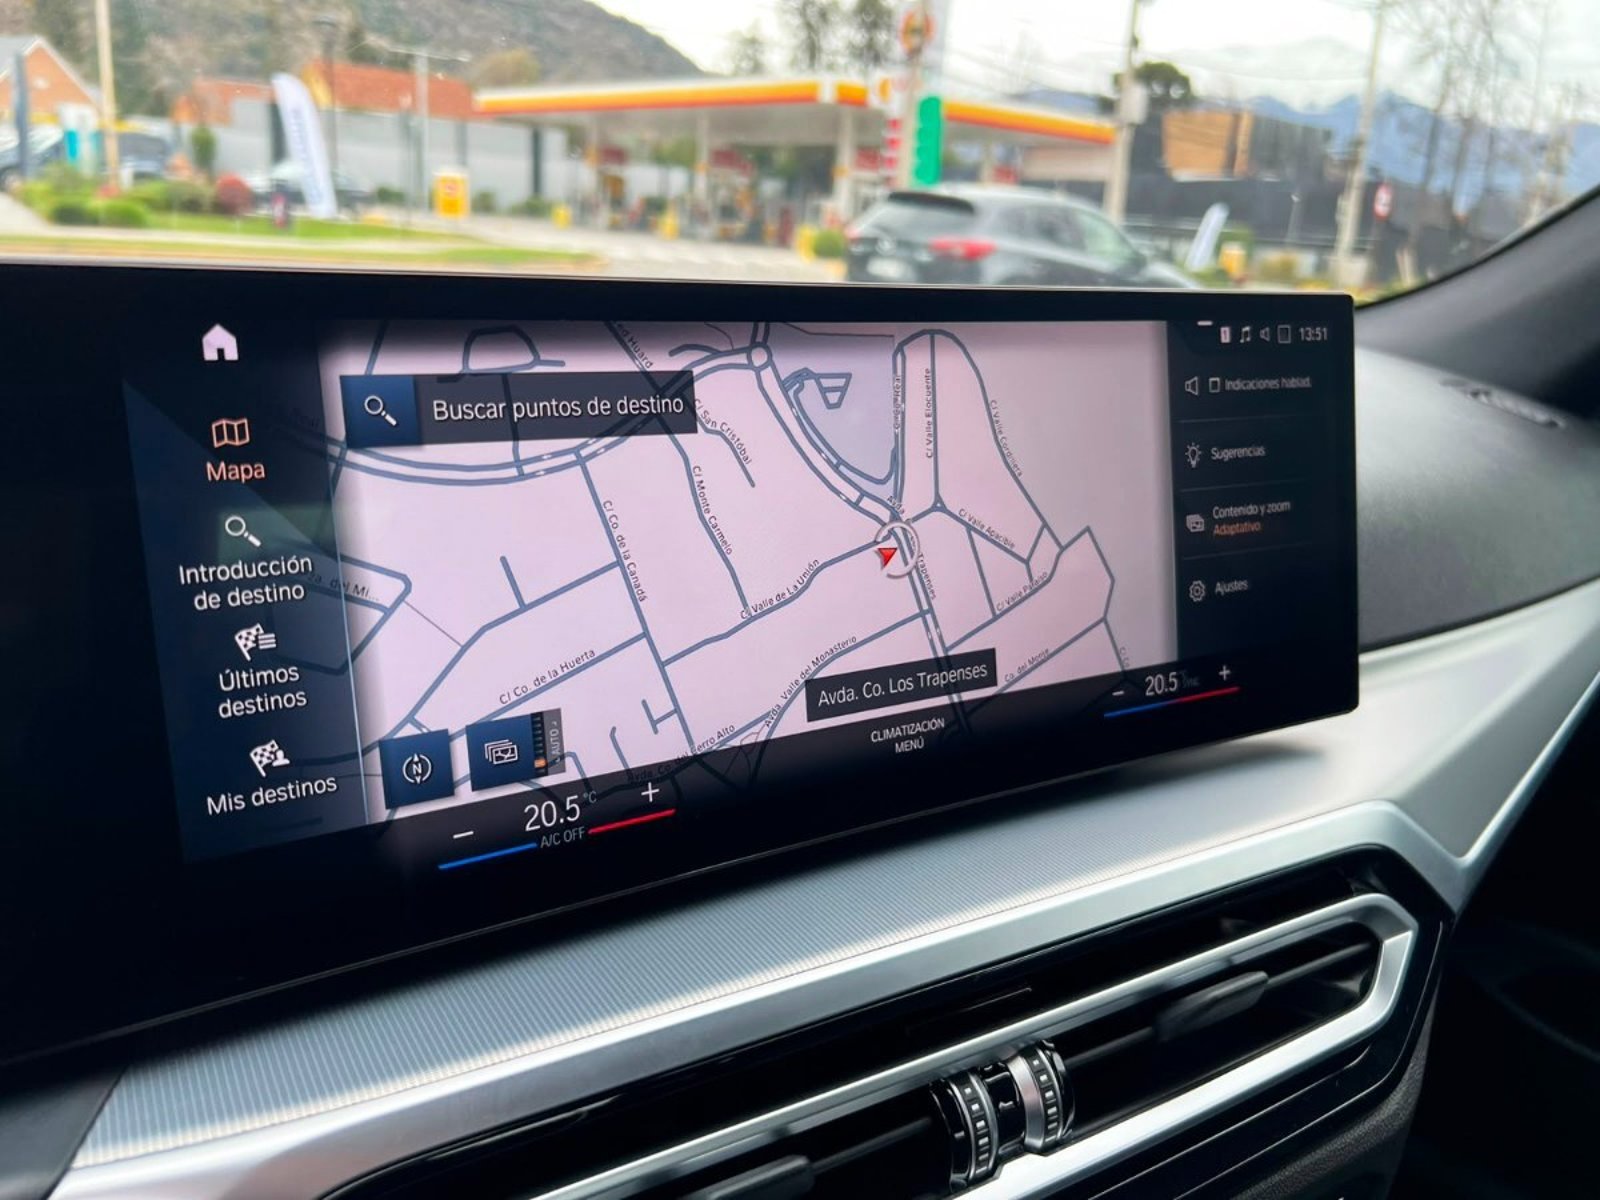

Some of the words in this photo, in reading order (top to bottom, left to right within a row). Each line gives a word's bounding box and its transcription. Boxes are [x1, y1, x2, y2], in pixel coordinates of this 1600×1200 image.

[1299, 327, 1328, 341] 13:51
[924, 368, 932, 418] Elocuente
[1225, 378, 1280, 391] Indicaciones
[433, 400, 506, 421] Buscar
[512, 398, 582, 422] puntos
[587, 397, 611, 416] de
[616, 394, 684, 416] destino
[925, 420, 933, 446] Valle
[993, 411, 1003, 435] Valle
[701, 410, 717, 428] San
[720, 421, 752, 465] Cristóbal
[926, 447, 933, 459] C/
[1211, 445, 1266, 461] Sugerencias
[206, 461, 265, 483] Mapa
[693, 465, 704, 477] C/
[696, 479, 711, 515] Monte
[1213, 504, 1259, 519] Contenido
[1259, 505, 1266, 516] y
[1266, 501, 1291, 513] zoom
[603, 500, 614, 512] C/
[616, 534, 627, 549] de
[622, 549, 631, 561] la
[708, 515, 733, 556] Carmelo
[967, 514, 985, 529] Valle
[986, 526, 1016, 548] Apacible
[1214, 521, 1261, 536] Adaptativo
[179, 555, 313, 585] Introducción
[918, 553, 937, 600] Trapenses
[194, 590, 221, 610] de
[227, 584, 305, 607] destino
[751, 598, 774, 613] Valle
[775, 591, 787, 603] de
[786, 585, 799, 597] La
[796, 559, 820, 586] Unión
[1004, 590, 1023, 607] Valle
[1215, 580, 1249, 596] Ajustes
[219, 666, 300, 692] Últimos
[500, 691, 511, 705] C/
[513, 684, 532, 697] Co.
[534, 675, 547, 687] de
[547, 668, 559, 679] la
[560, 649, 596, 673] Huerta
[780, 678, 800, 700] Valle
[799, 664, 812, 680] del
[811, 636, 857, 667] Monasterio
[817, 687, 858, 708] Avda.
[862, 681, 885, 699] Co.
[889, 675, 914, 694] Los
[917, 663, 988, 688] Trapenses
[1145, 671, 1178, 697] 20.5
[218, 691, 308, 719] destinos
[716, 724, 736, 740] Alto
[871, 717, 945, 743] CLIMATIZACIÓN
[895, 736, 925, 754] MENÚ
[207, 794, 245, 816] Mis
[251, 776, 338, 806] destinos
[523, 794, 582, 832] 20.5
[583, 791, 597, 803] °C
[540, 832, 561, 848] A/C
[563, 826, 585, 843] OFF
